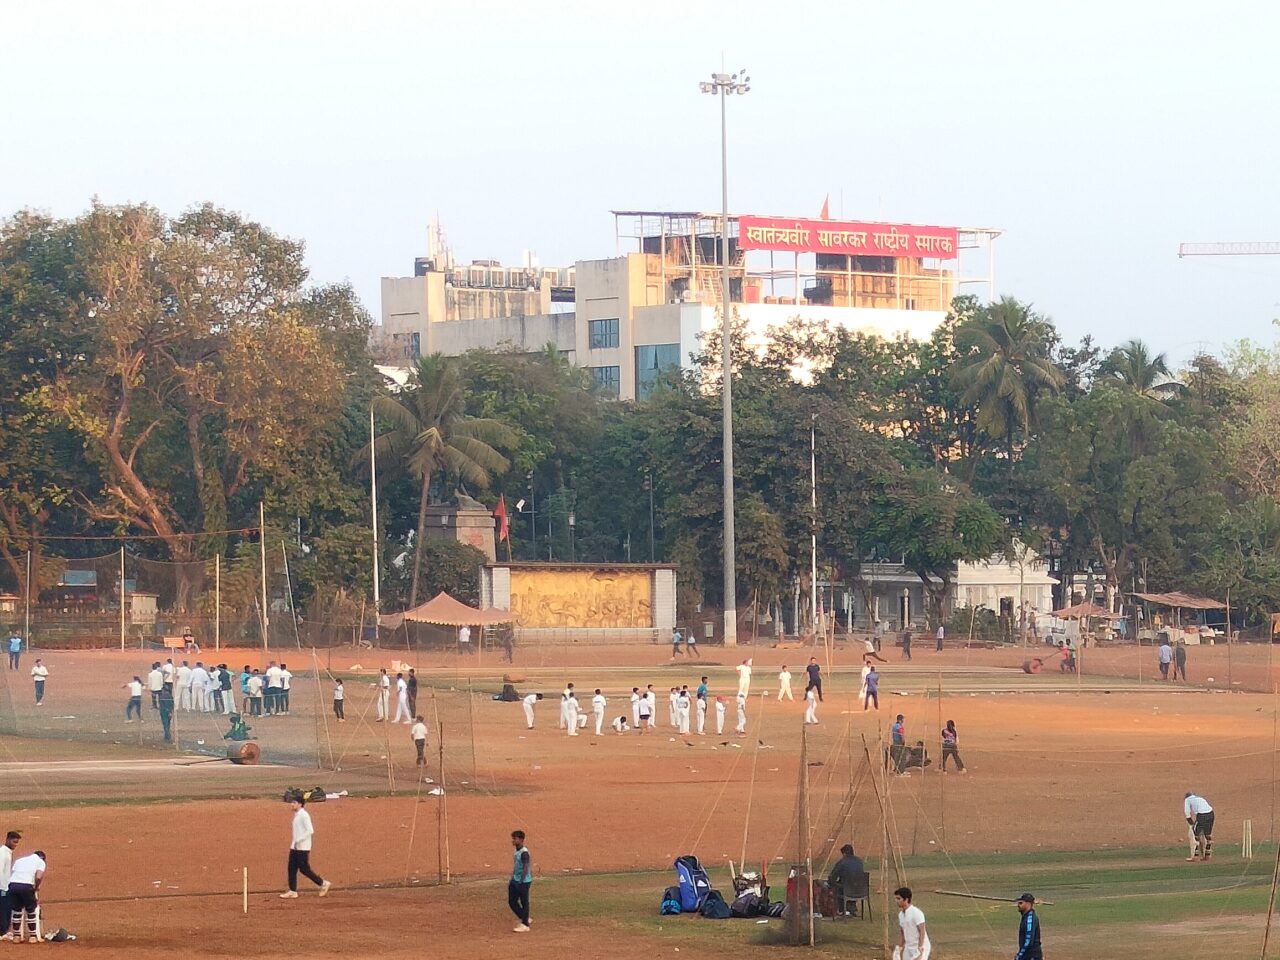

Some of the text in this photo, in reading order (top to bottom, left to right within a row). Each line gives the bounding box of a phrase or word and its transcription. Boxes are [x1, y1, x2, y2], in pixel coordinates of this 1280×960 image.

[817, 230, 867, 248] सावरकर
[873, 227, 910, 254] राष्ट्रीय
[914, 234, 953, 253] स्मारक
